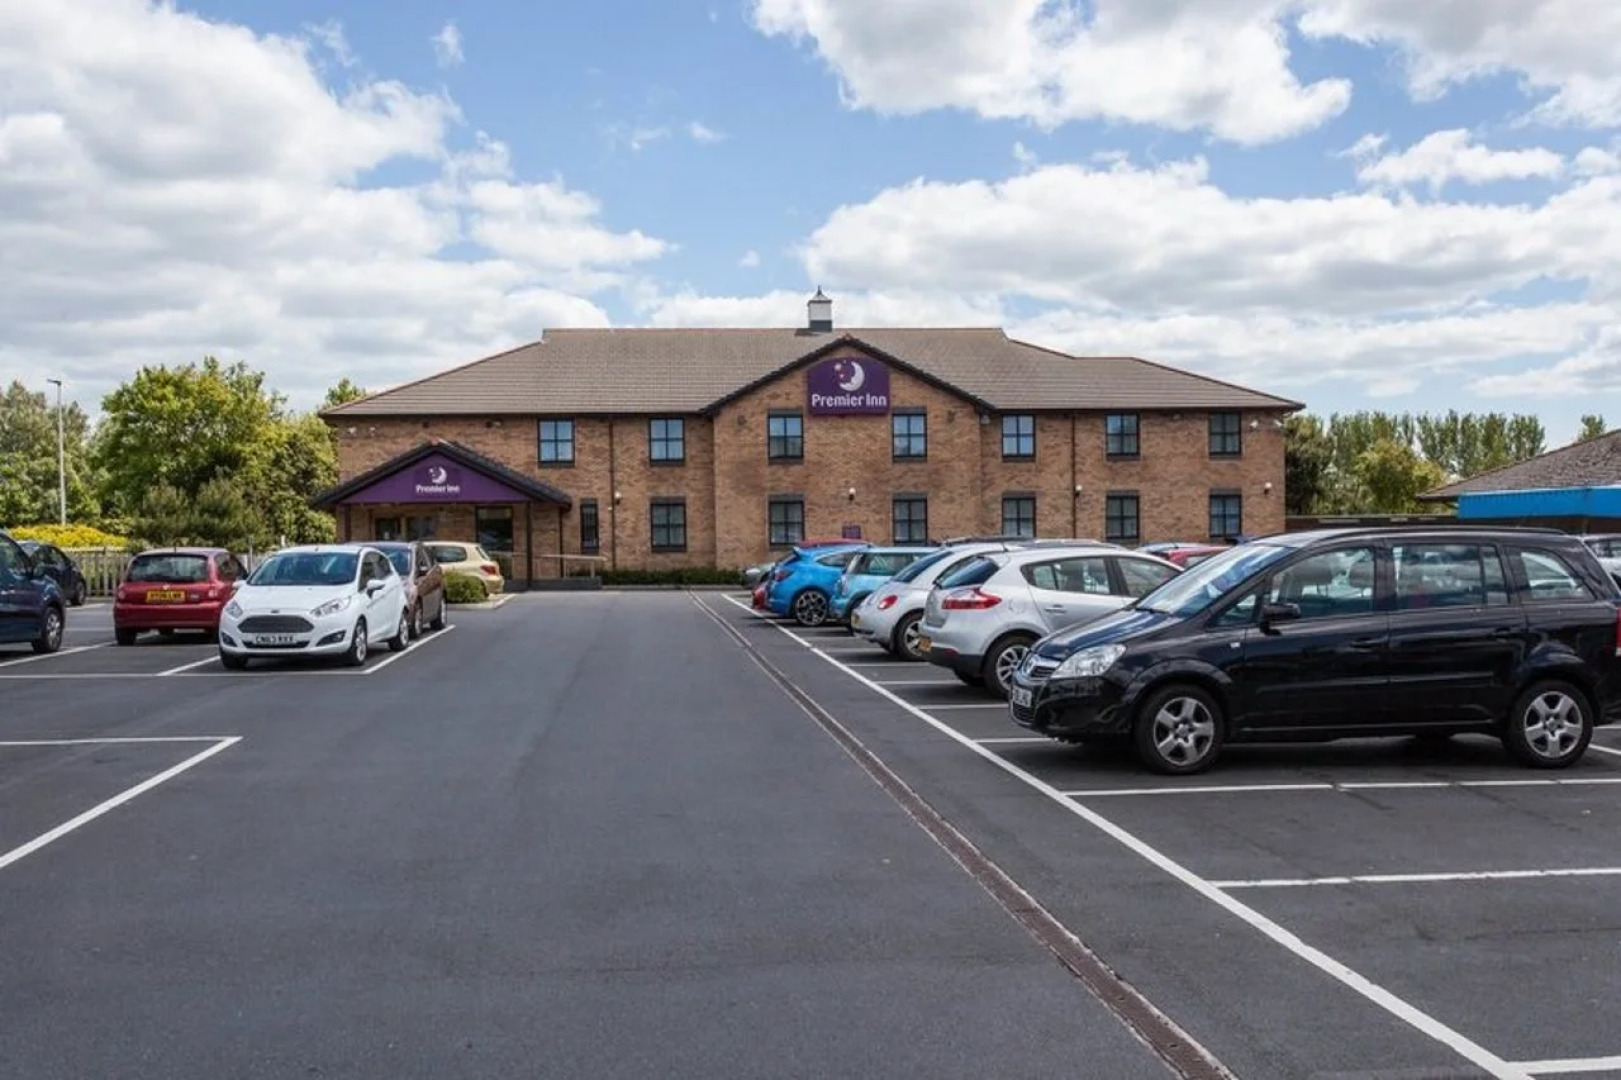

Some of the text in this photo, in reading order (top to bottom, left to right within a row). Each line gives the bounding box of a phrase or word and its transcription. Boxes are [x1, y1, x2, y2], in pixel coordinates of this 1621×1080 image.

[811, 393, 887, 407] Premier Inn
[415, 484, 460, 494] Premier Inn
